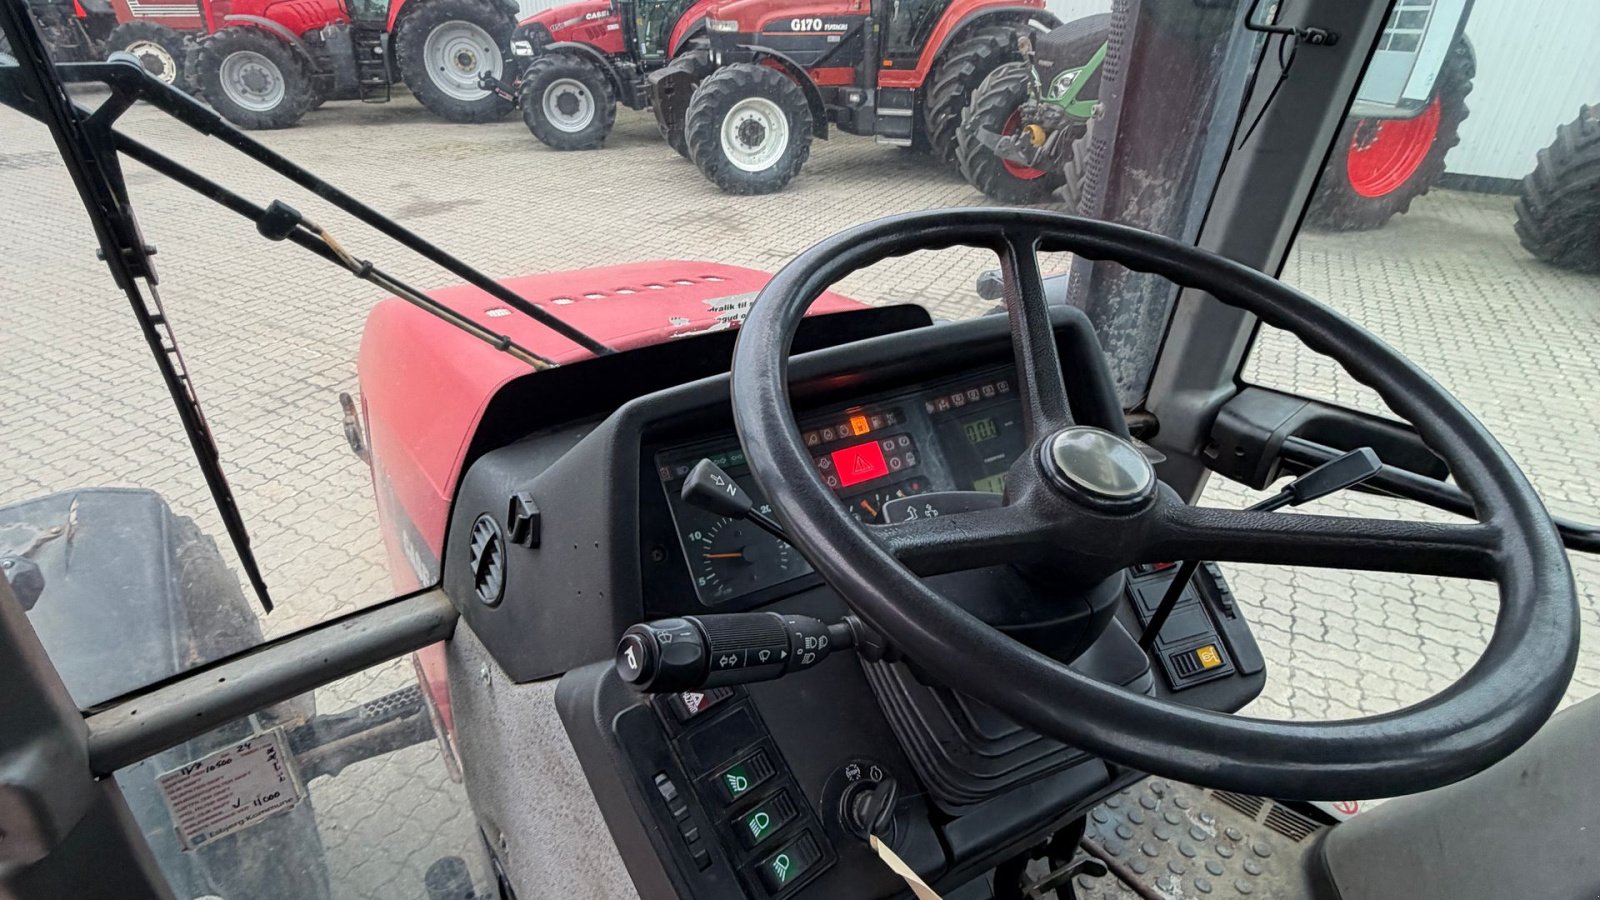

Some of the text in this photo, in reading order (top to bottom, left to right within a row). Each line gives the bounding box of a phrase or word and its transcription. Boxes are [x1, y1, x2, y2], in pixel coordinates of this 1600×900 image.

[586, 11, 606, 20] CASE
[791, 18, 822, 31] G170
[738, 301, 747, 309] til
[726, 484, 736, 497] N
[689, 531, 702, 541] 10
[699, 577, 706, 586] 5
